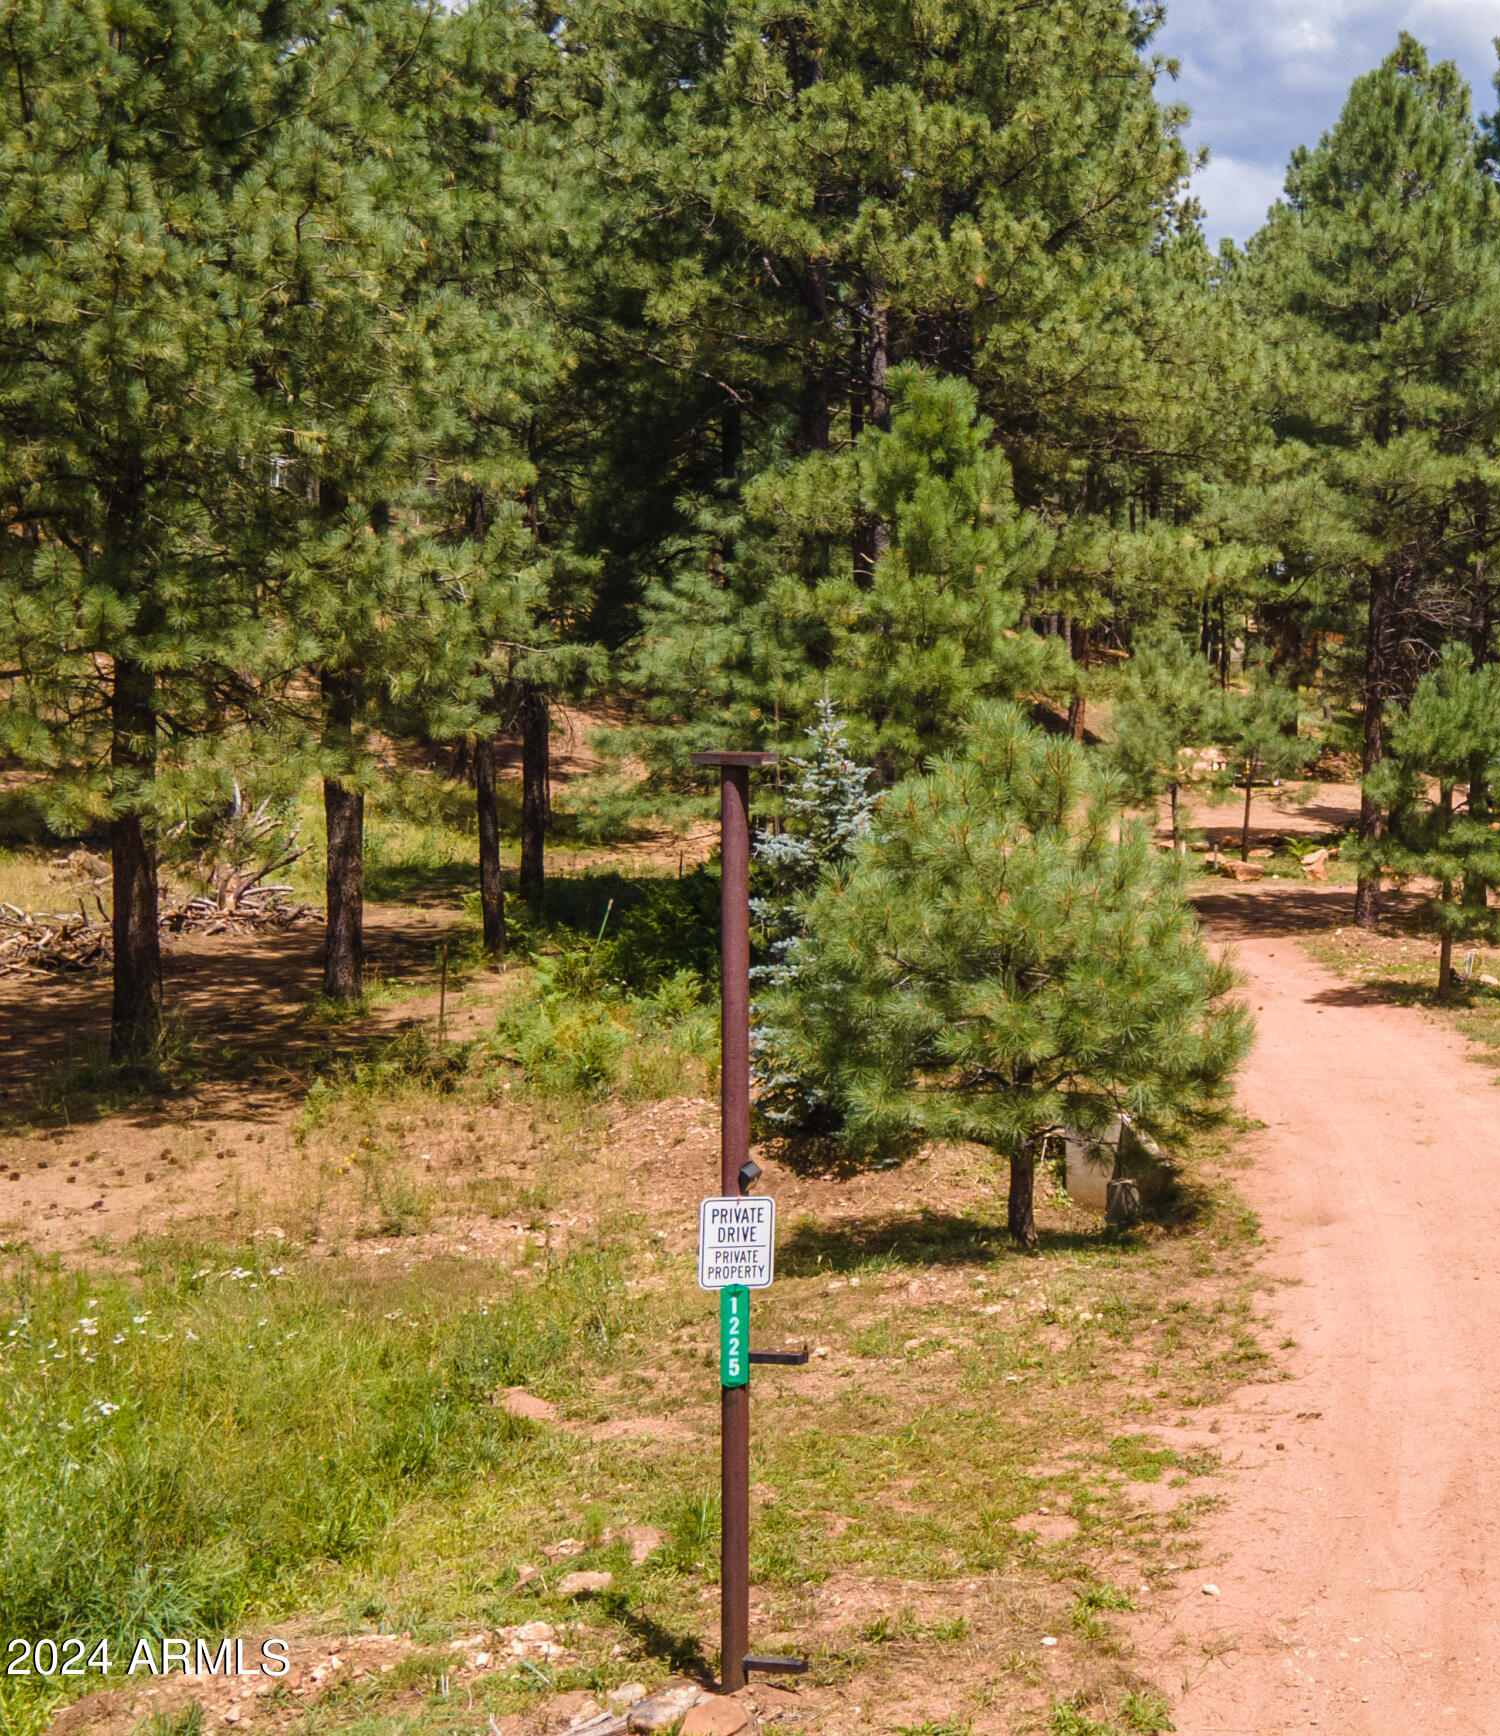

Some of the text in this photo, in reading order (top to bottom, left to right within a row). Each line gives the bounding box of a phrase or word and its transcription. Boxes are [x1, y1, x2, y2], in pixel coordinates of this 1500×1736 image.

[712, 1207, 764, 1224] PRIVATE
[717, 1226, 757, 1243] DRIVE
[715, 1250, 759, 1264] PRIVATE
[708, 1265, 765, 1279] PROPERTY
[728, 1296, 740, 1376] 1225
